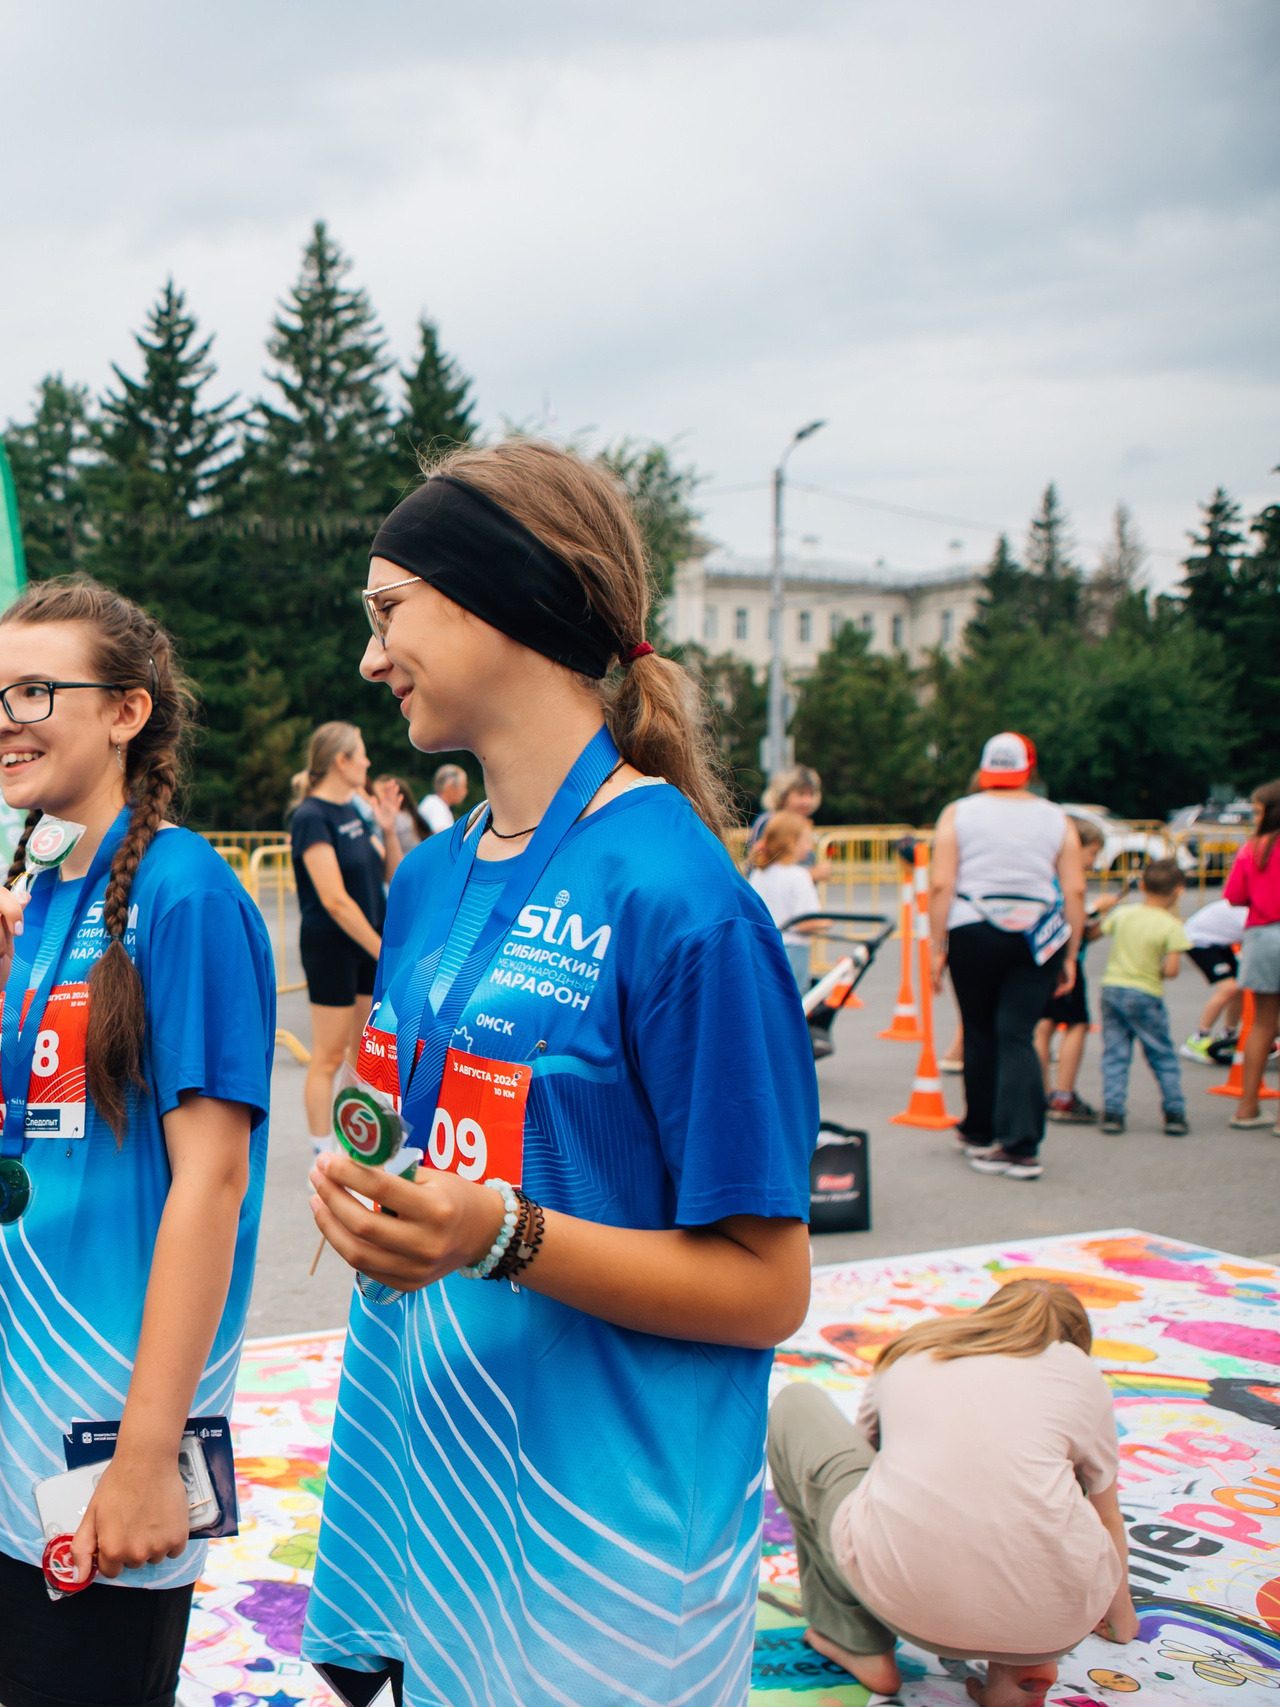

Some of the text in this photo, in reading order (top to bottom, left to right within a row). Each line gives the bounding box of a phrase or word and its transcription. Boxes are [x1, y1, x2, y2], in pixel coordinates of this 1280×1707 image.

[497, 957, 595, 993] МЕЖДУНАРОДНЫЙ
[503, 942, 600, 981] СИБИРСКИЙ
[490, 967, 591, 1011] МАРАФОН
[476, 1013, 516, 1035] ОМСК
[453, 1062, 518, 1087] 3 АВГУСТА 2024
[494, 1087, 515, 1099] 10 КМ
